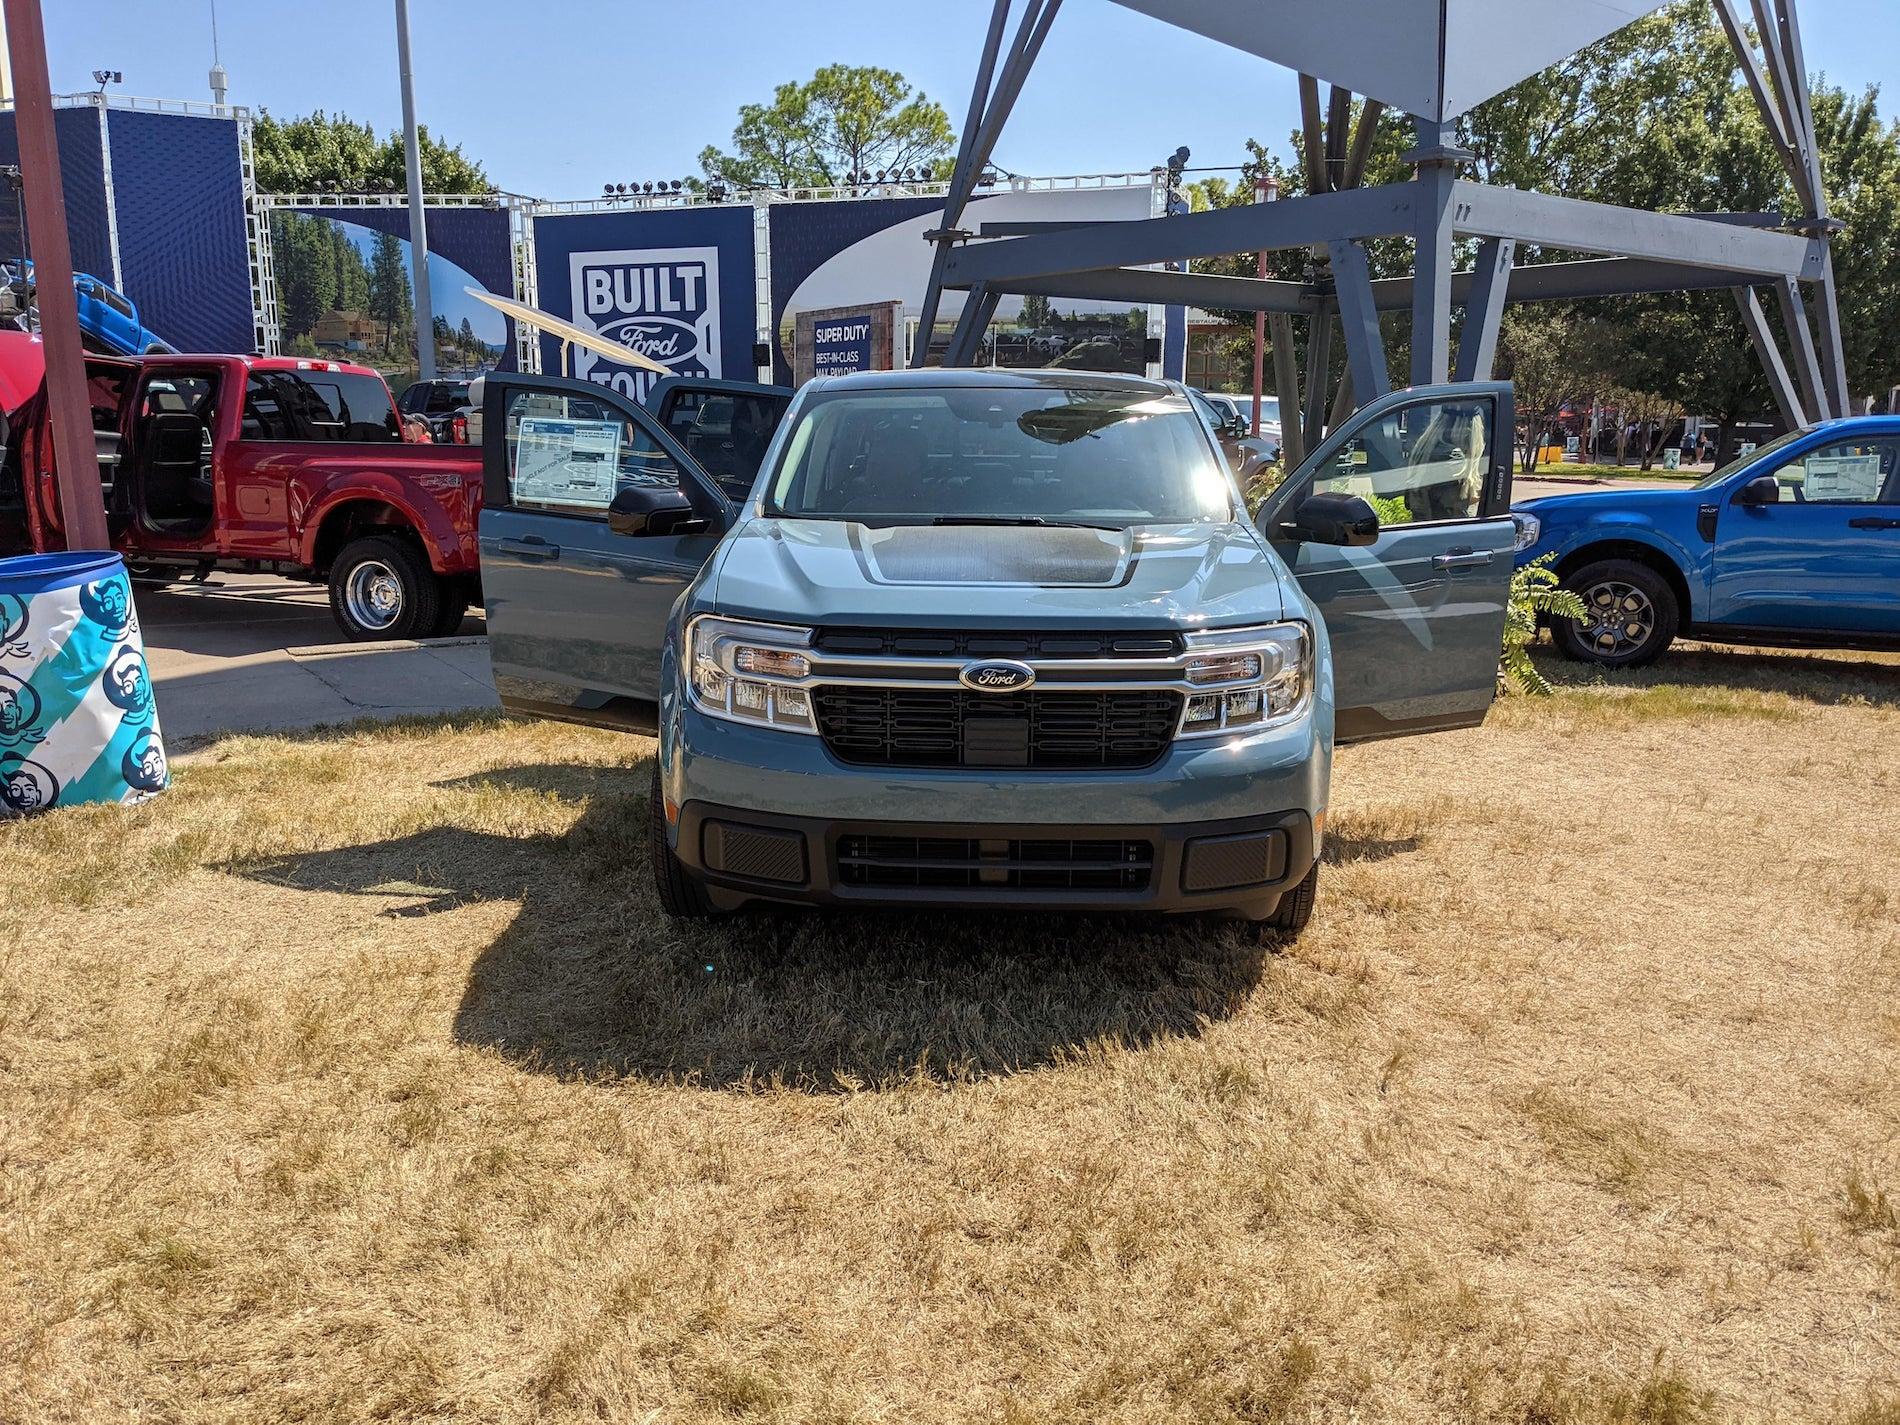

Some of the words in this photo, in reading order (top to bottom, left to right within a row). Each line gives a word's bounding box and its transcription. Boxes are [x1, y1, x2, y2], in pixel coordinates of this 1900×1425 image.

[586, 265, 704, 315] BUILT
[617, 325, 680, 356] Ford
[816, 327, 842, 343] SUPER
[816, 351, 859, 364] BEST-IN-CLASS
[830, 366, 857, 377] PAYLOAD
[978, 668, 1017, 686] Ford
